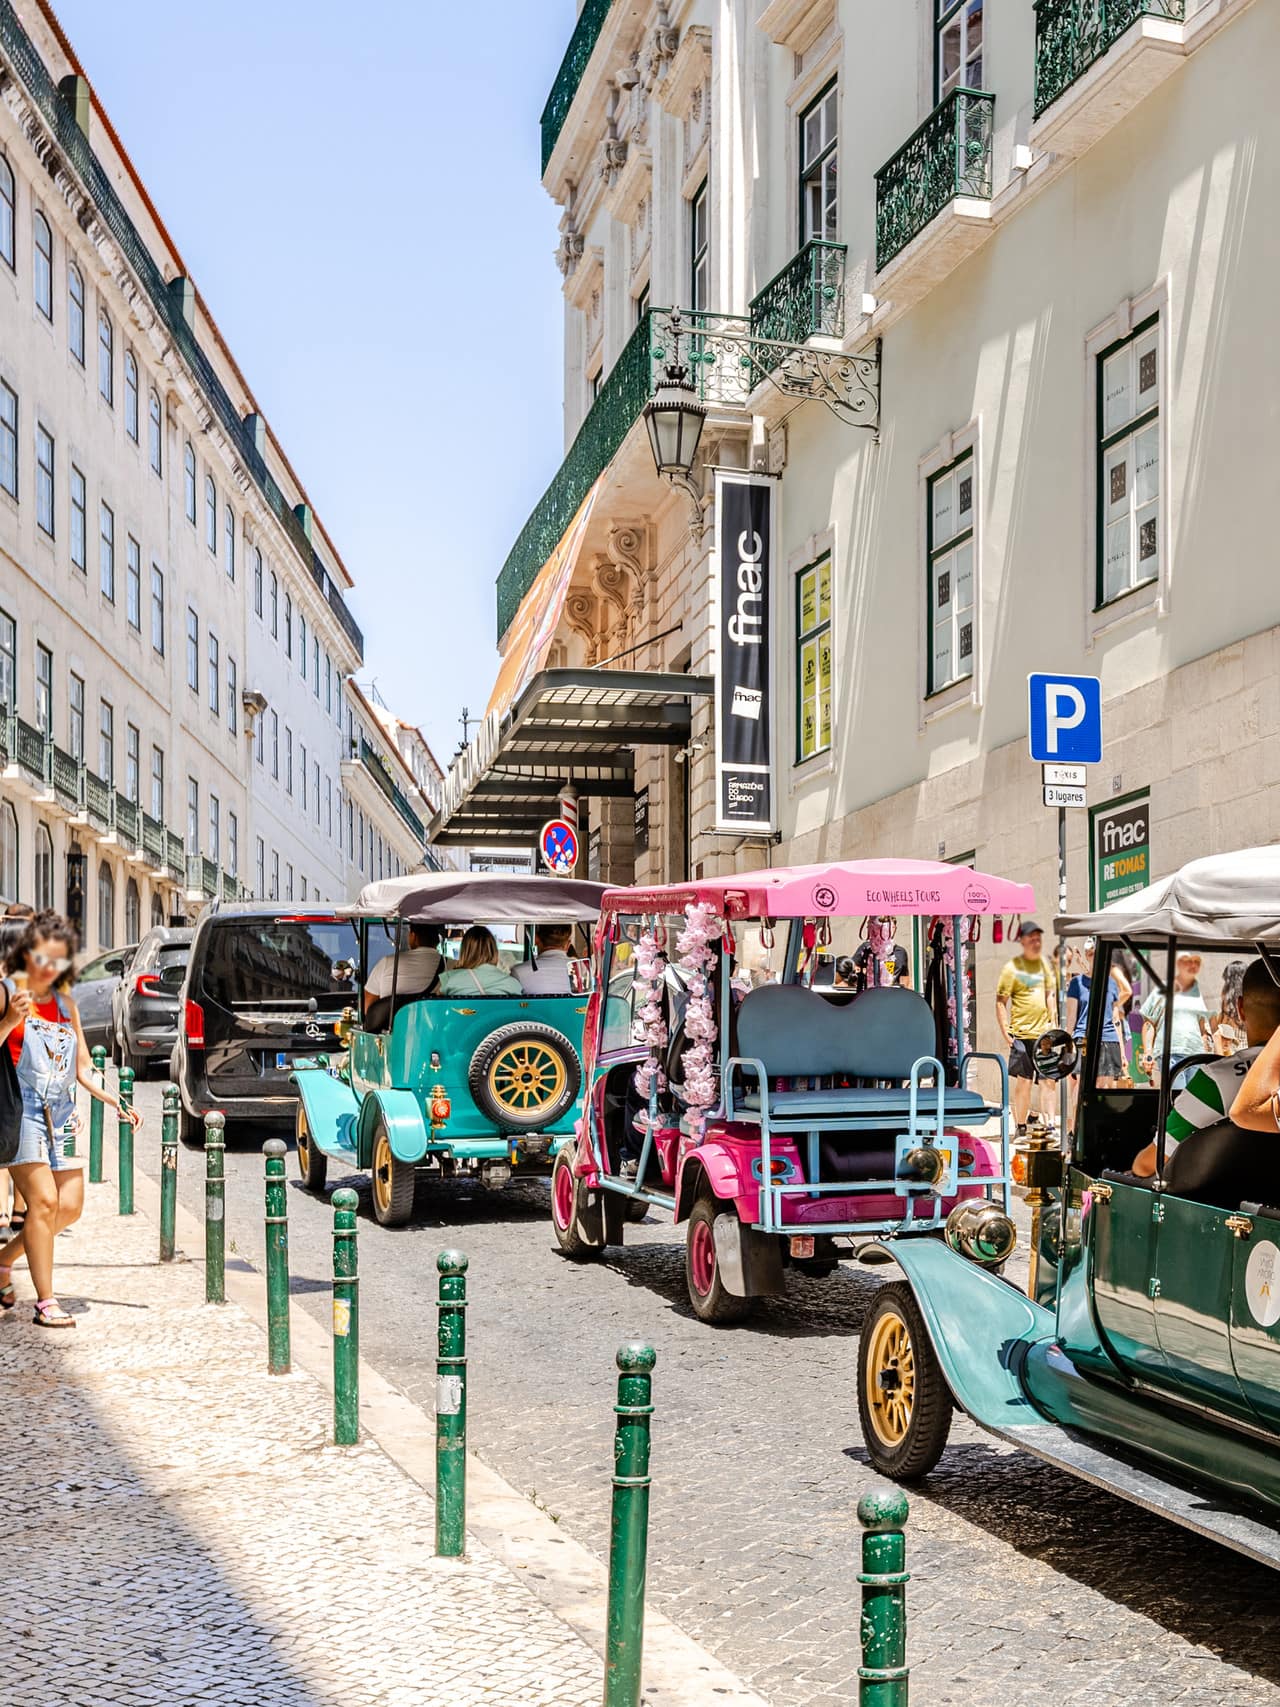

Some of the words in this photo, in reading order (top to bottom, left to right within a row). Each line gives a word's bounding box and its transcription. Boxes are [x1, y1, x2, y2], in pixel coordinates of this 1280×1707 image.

[727, 529, 763, 647] fnac
[734, 691, 761, 703] fnac
[1045, 683, 1086, 754] P
[1048, 789, 1055, 801] 3
[1055, 789, 1083, 804] lugares
[1103, 819, 1146, 853] fnac
[1103, 852, 1146, 881] RETOMAS
[882, 889, 914, 902] WHEELS
